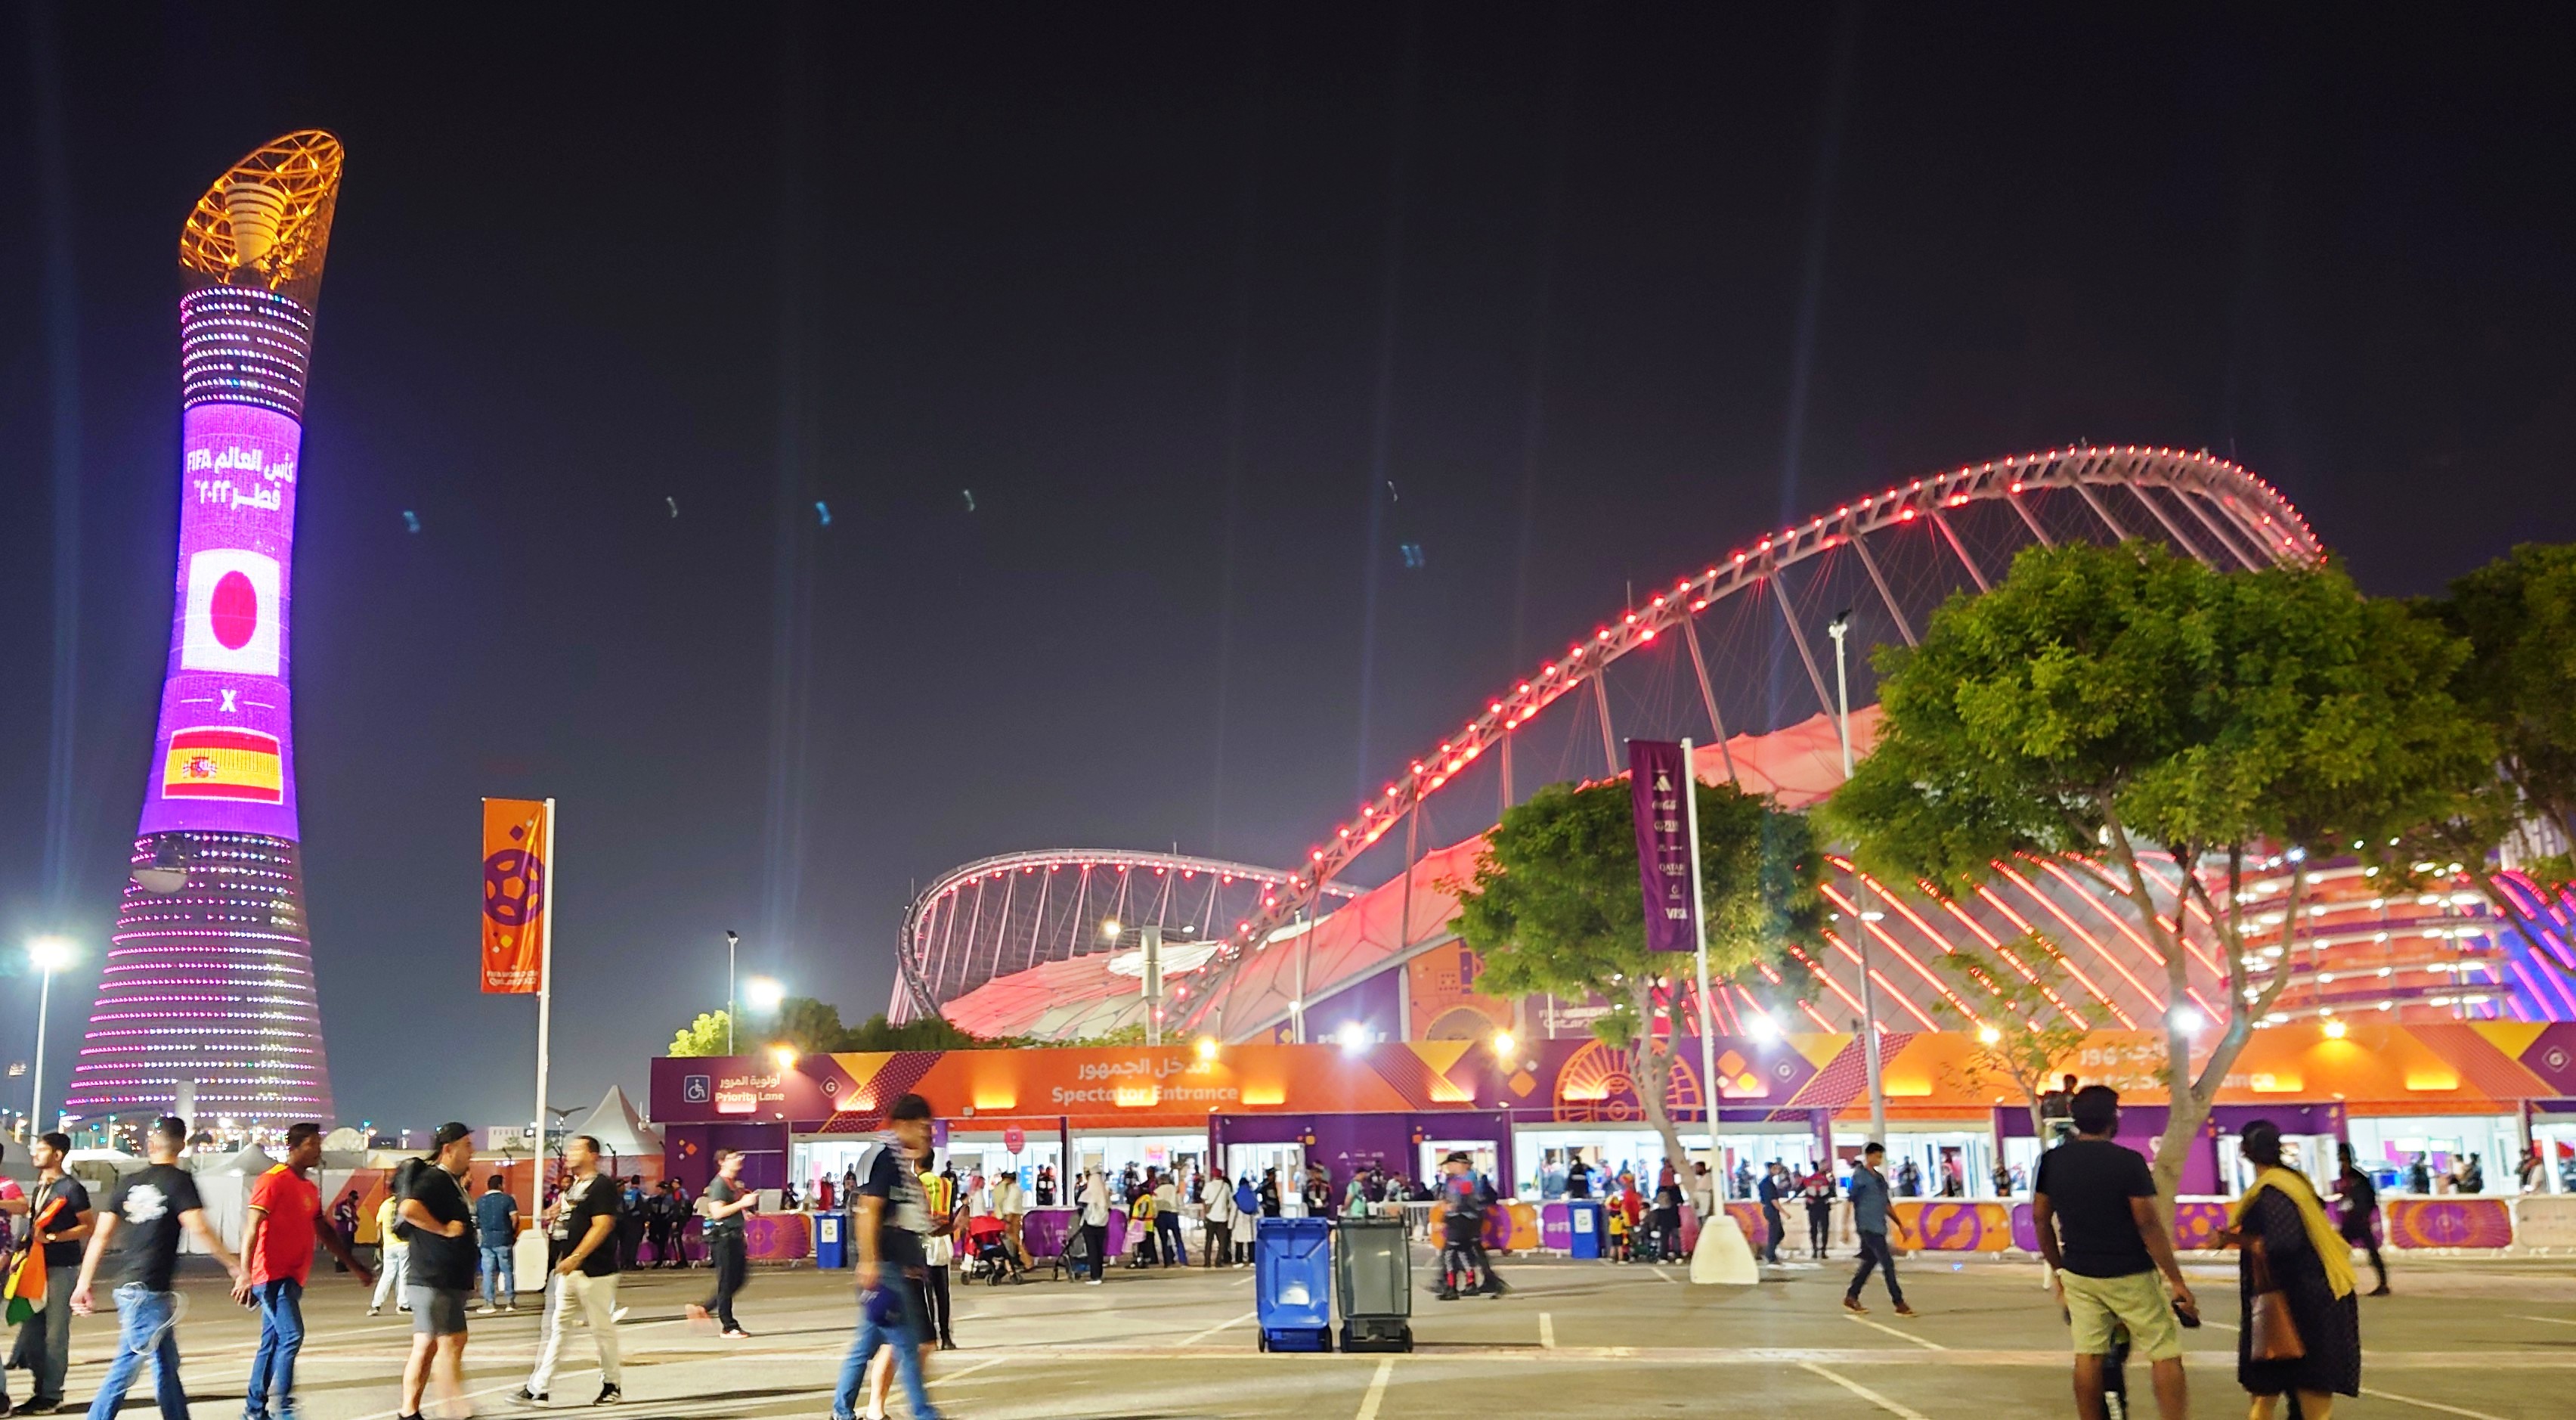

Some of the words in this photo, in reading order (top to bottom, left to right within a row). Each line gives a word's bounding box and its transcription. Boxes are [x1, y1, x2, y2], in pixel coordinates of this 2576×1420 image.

[187, 448, 212, 473] FIFA
[214, 446, 262, 474] العالم
[220, 689, 237, 712] X
[1665, 908, 1687, 919] VISA
[2549, 1053, 2563, 1065] G
[1078, 1059, 1150, 1080] الجمهور
[825, 1081, 835, 1091] G
[1051, 1086, 1147, 1106] Spectator
[1152, 1086, 1238, 1102] Entrance
[715, 1092, 757, 1104] Priority
[759, 1091, 785, 1102] Lane
